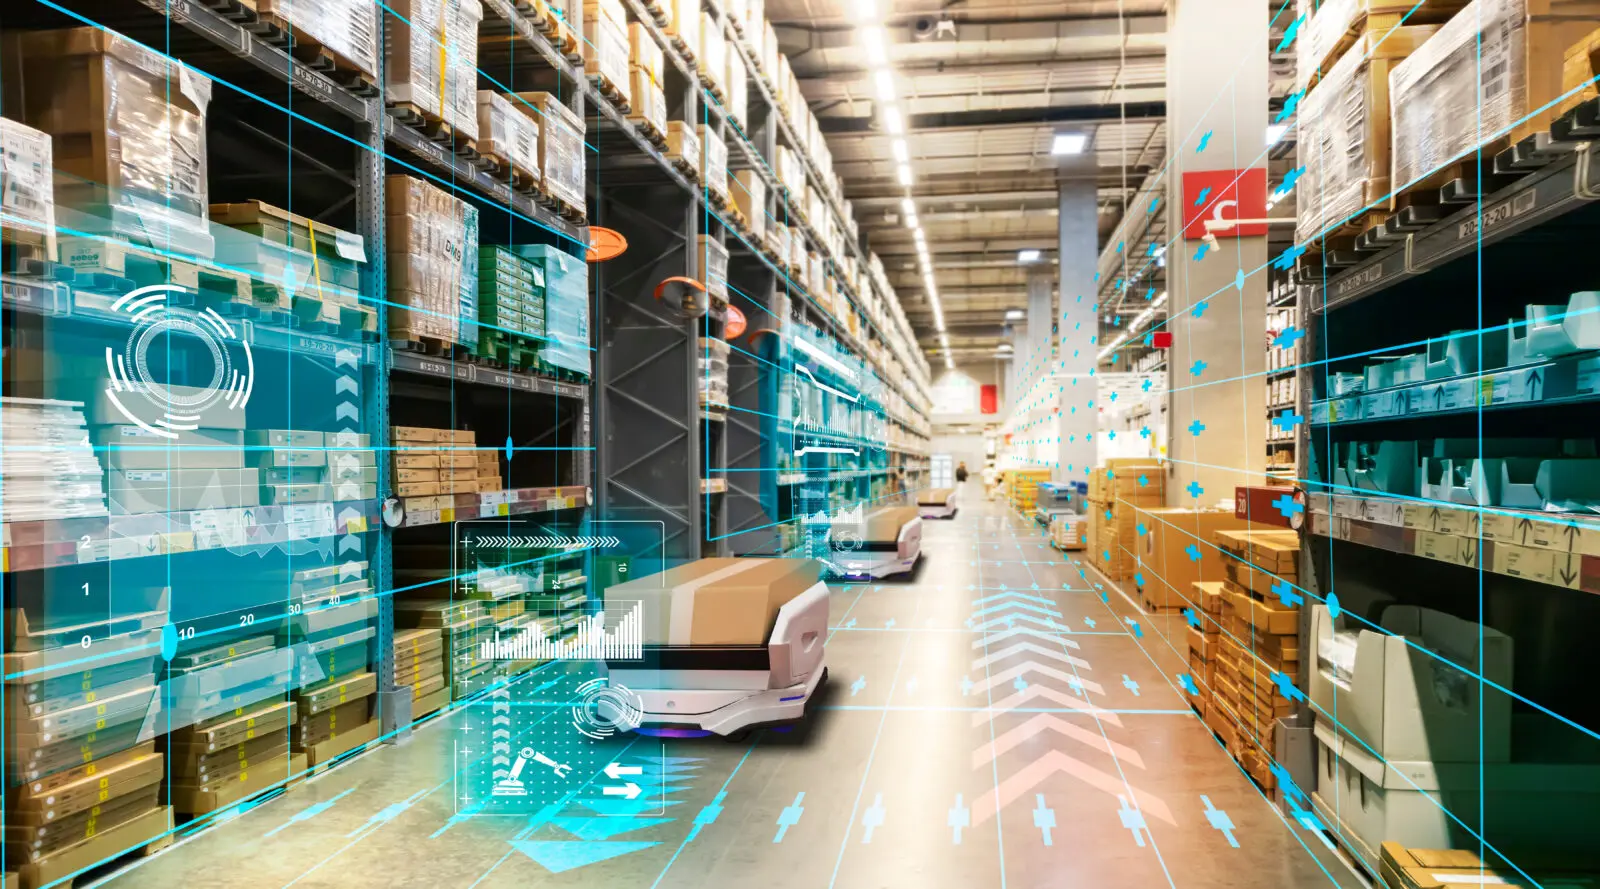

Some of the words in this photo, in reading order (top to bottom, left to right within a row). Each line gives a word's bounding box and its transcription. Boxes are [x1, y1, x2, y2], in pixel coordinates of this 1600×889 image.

[299, 70, 329, 91] 19-70-30
[303, 339, 334, 352] 19-70-20
[1238, 498, 1247, 514] 20
